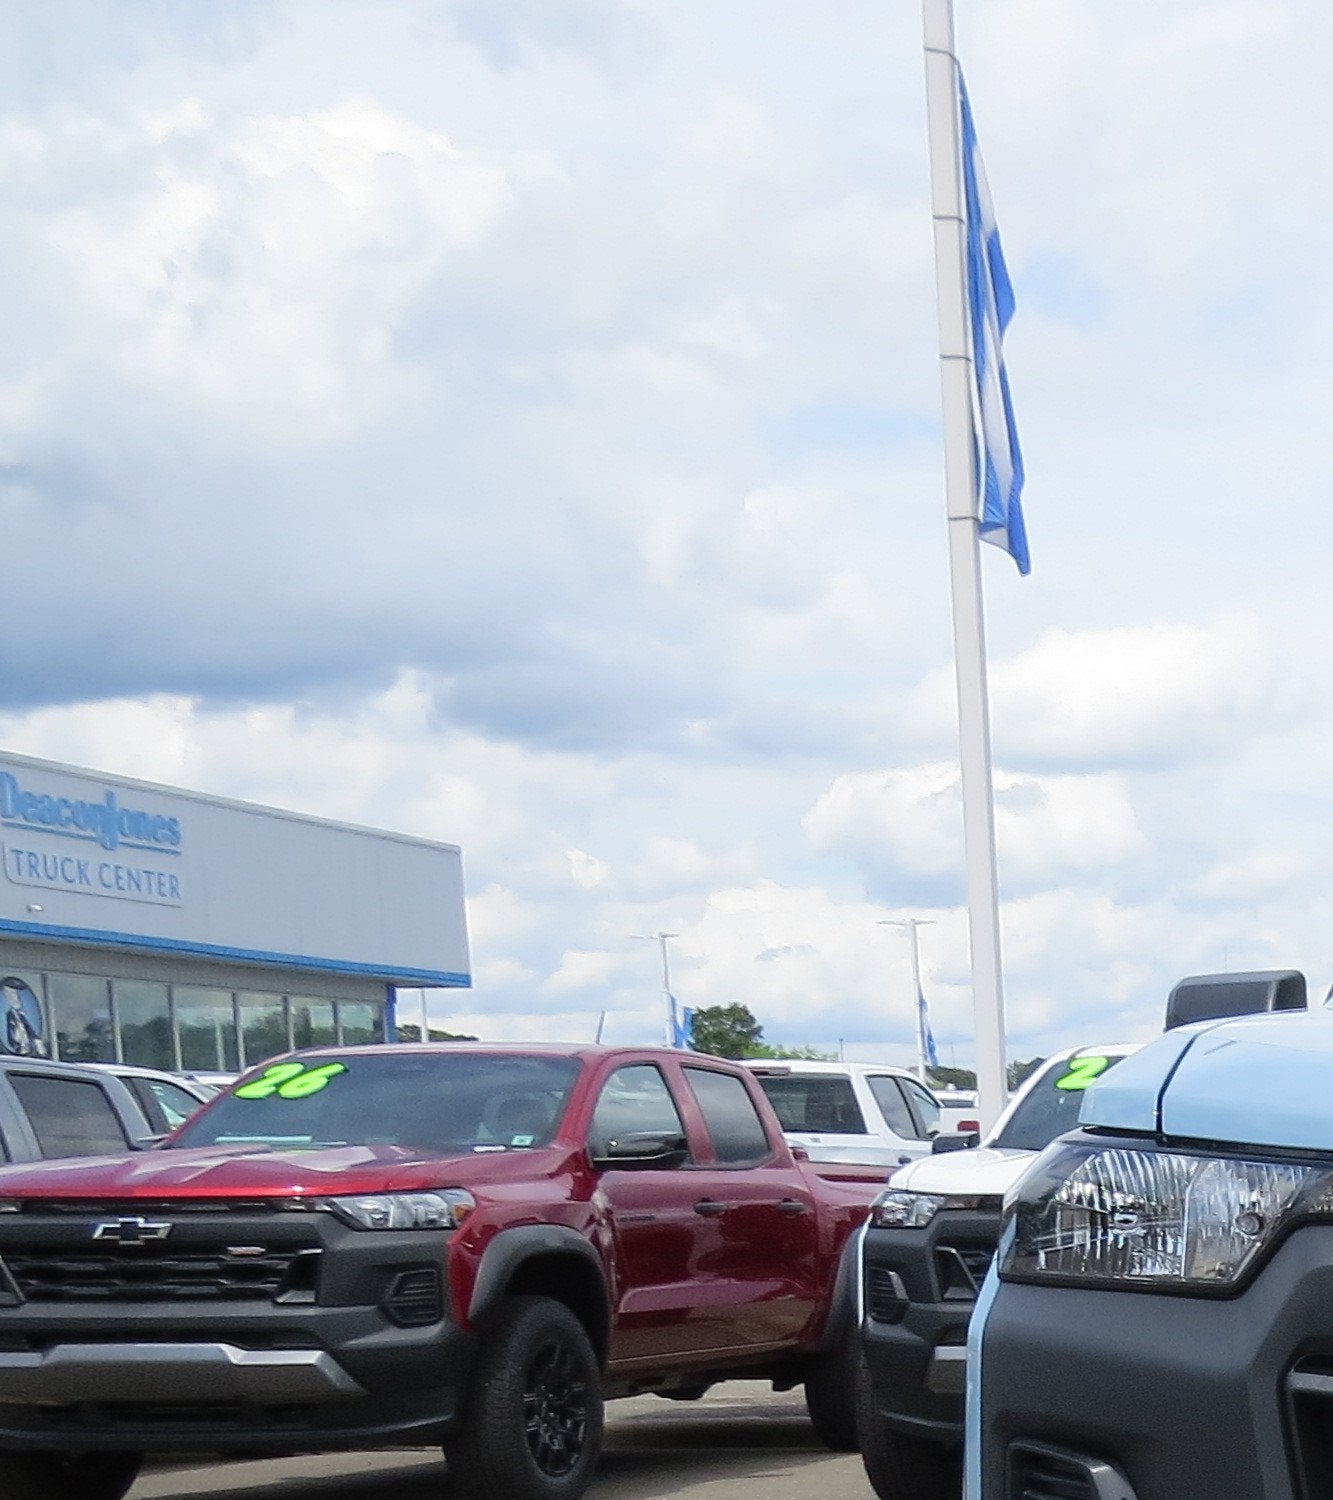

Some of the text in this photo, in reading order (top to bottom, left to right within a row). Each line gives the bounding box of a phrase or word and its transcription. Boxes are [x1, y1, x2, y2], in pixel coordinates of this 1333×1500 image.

[11, 849, 182, 899] TRUCK CENTER
[232, 1061, 347, 1100] 26
